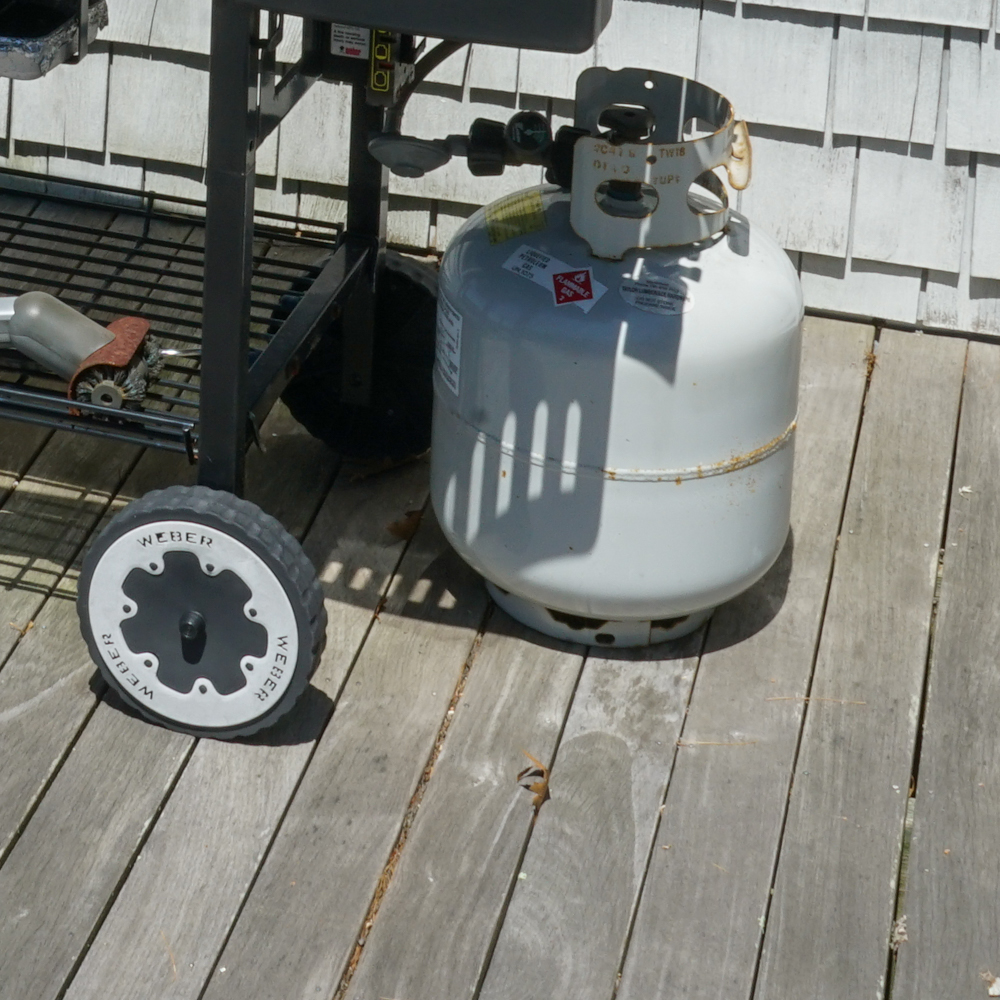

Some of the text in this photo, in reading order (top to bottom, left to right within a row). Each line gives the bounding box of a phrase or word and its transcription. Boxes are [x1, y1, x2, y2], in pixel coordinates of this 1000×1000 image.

[555, 274, 590, 298] FLAMMABLE
[560, 286, 574, 297] GAS
[137, 530, 213, 548] WEBER
[102, 633, 154, 700] WEBER
[254, 635, 288, 702] WEBER
